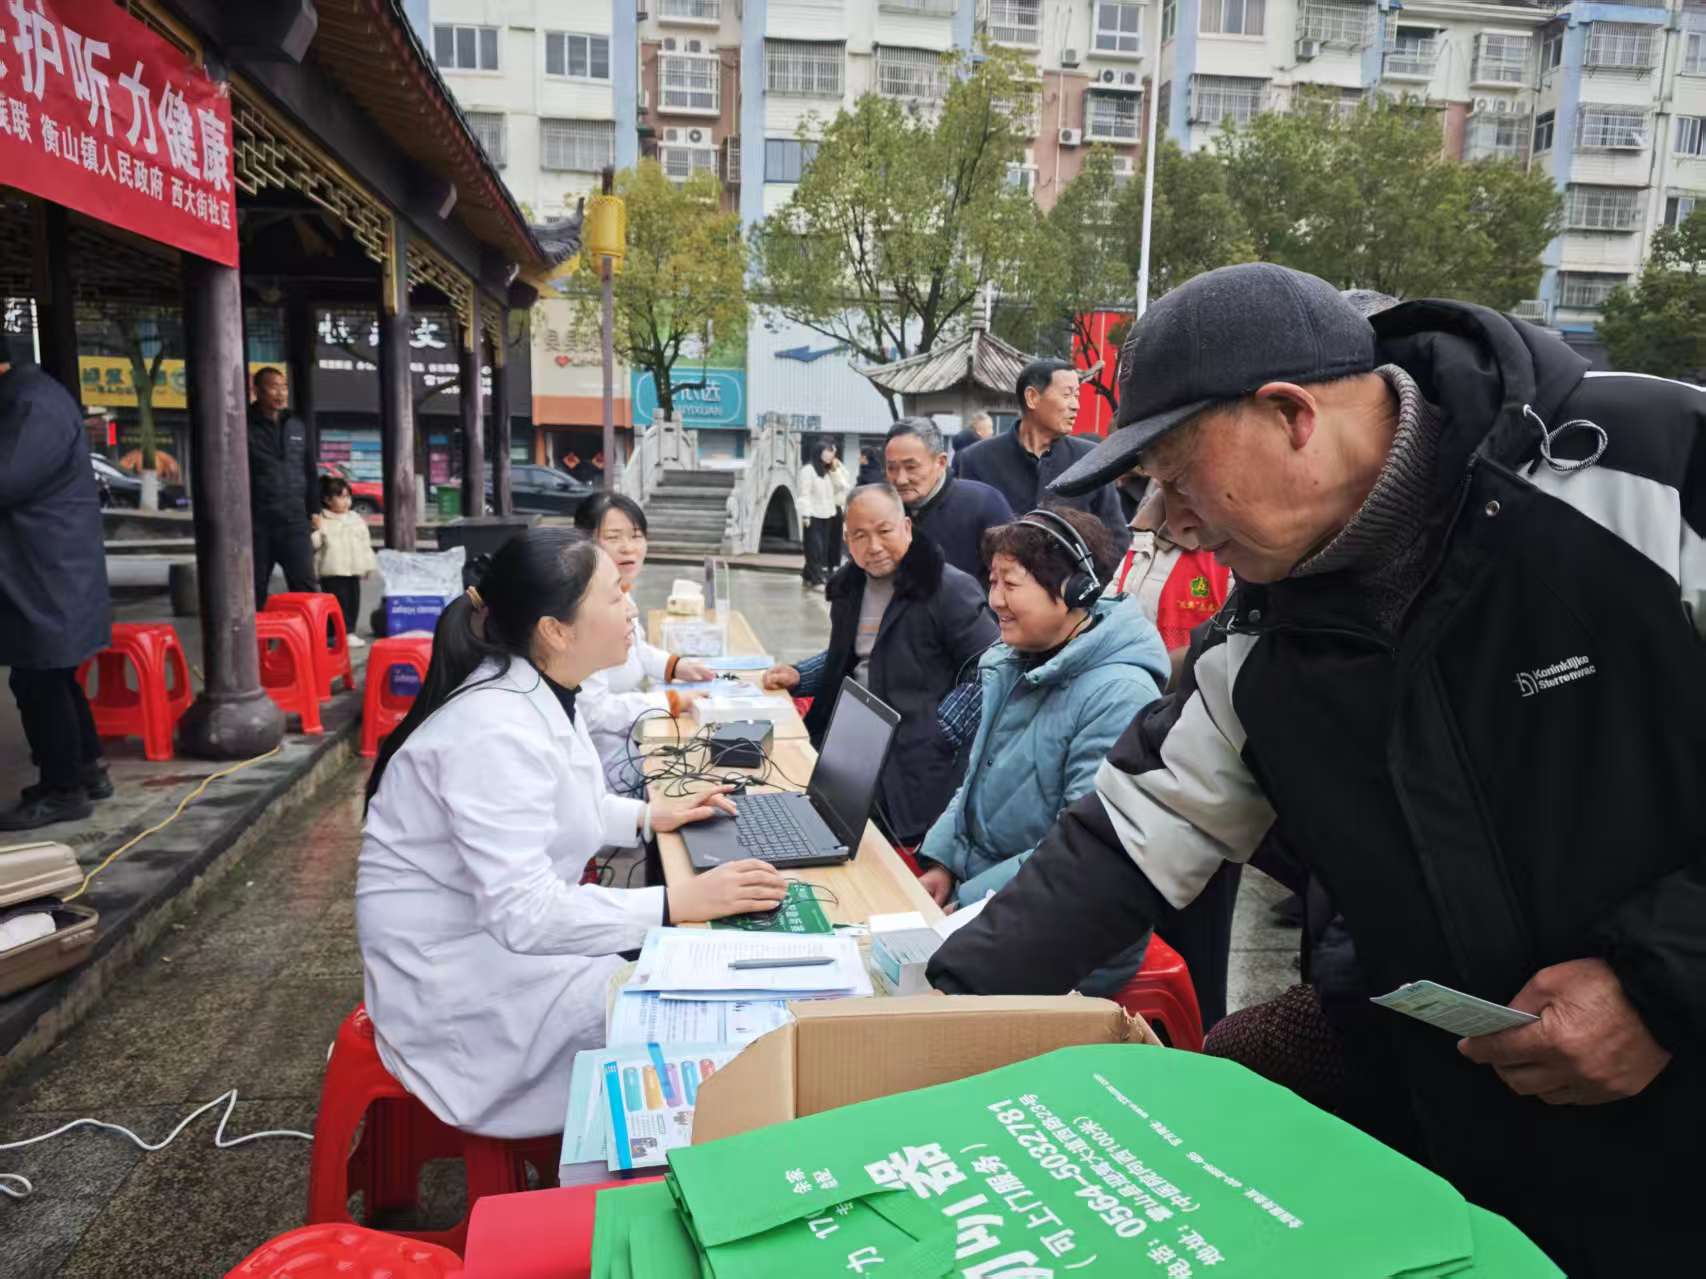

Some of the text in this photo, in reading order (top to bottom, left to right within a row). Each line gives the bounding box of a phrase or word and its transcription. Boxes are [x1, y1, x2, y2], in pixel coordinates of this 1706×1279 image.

[0, 0, 231, 193] 护听力健康
[40, 113, 164, 201] 衡山镇人民政府
[170, 176, 232, 231] 西大街社区
[803, 1209, 840, 1240] 17
[987, 1099, 1148, 1239] 0564-5032781
[845, 1246, 886, 1279] 力
